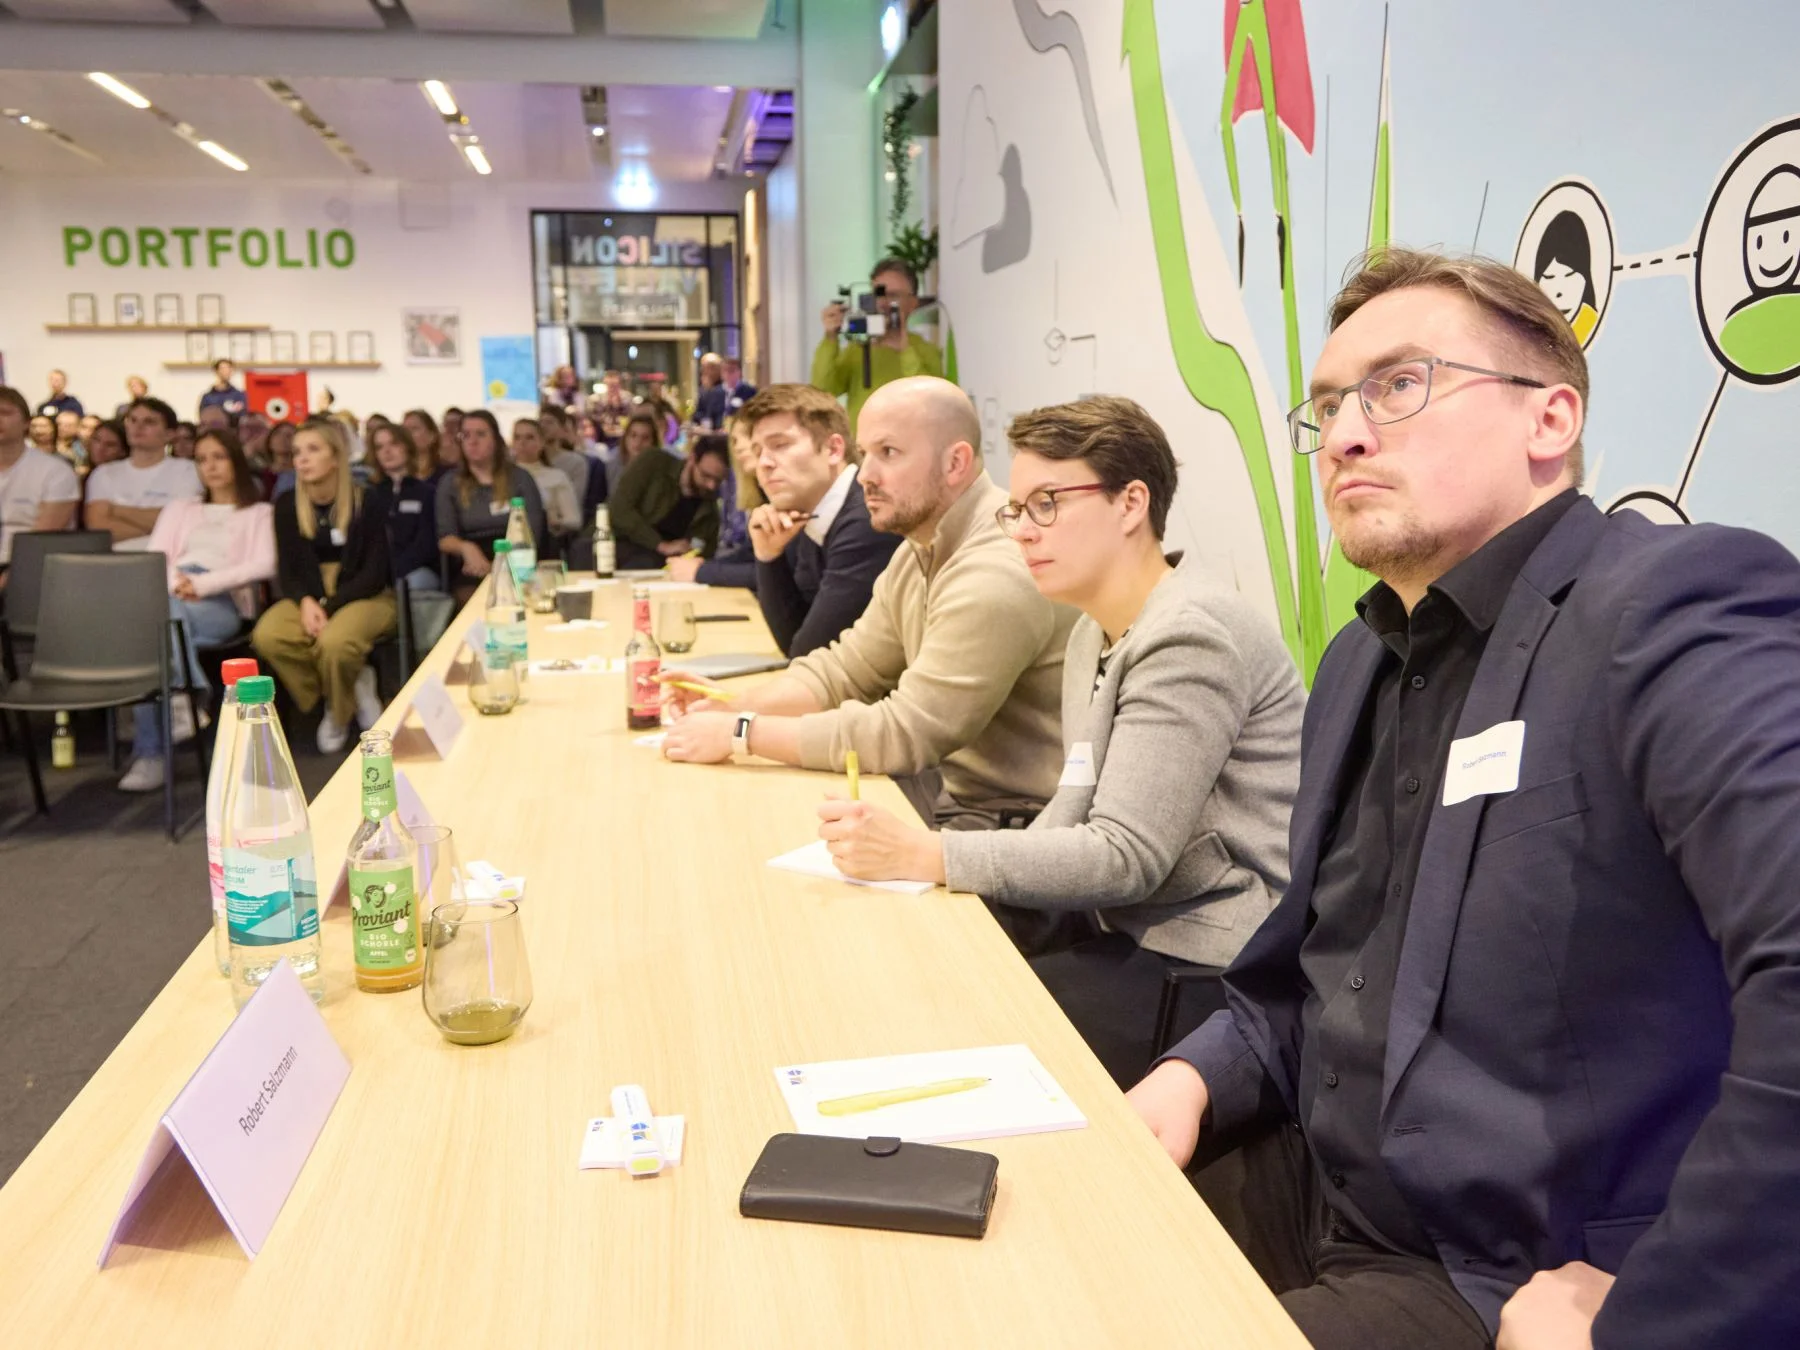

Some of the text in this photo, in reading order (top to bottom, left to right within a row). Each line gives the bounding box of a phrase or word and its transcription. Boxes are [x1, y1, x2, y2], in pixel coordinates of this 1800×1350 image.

[62, 226, 357, 269] PORTFOLIO
[352, 900, 412, 926] Proviant
[238, 1046, 298, 1137] Robert Salzmann
